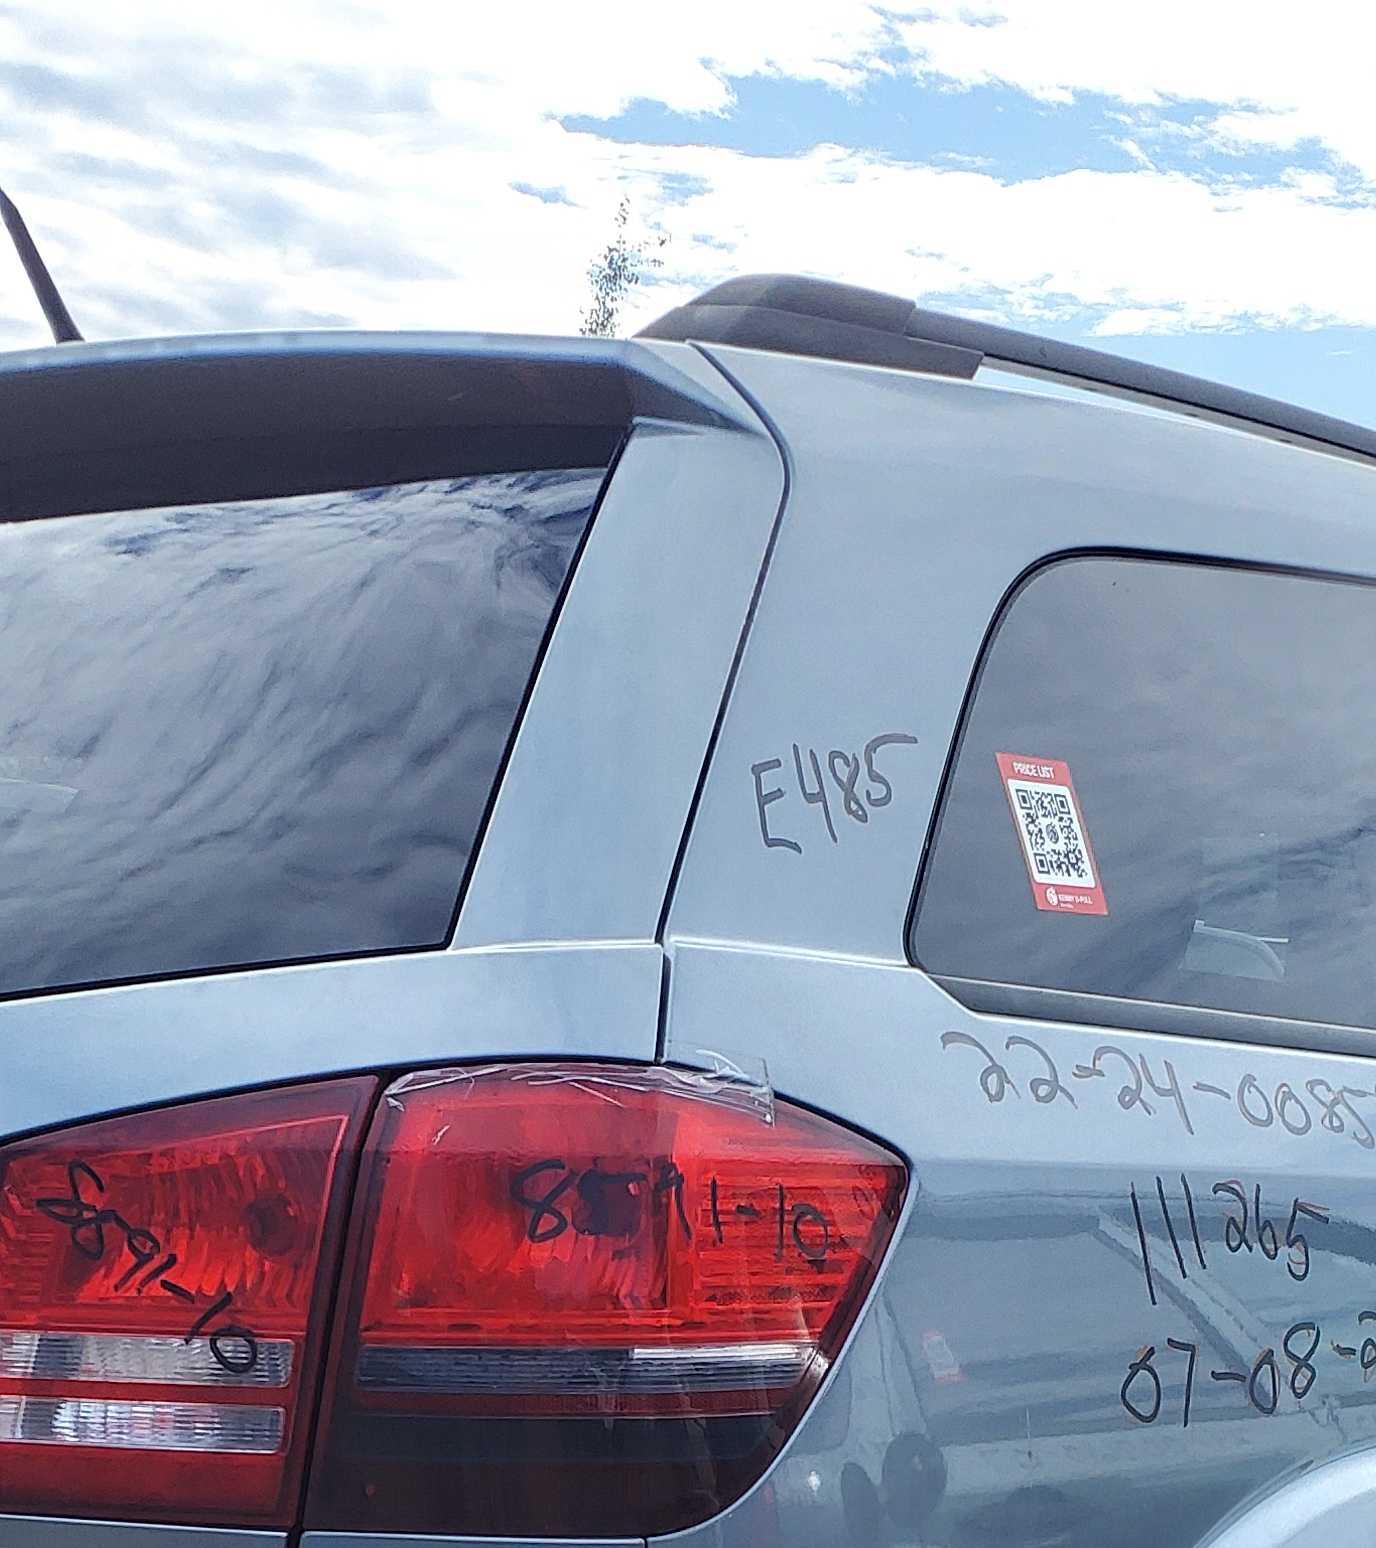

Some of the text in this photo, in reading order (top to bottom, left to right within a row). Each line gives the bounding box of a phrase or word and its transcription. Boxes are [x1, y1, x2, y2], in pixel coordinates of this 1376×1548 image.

[751, 733, 918, 854] E485
[1037, 765, 1055, 779] LIST
[1130, 1173, 1330, 1306] 111265
